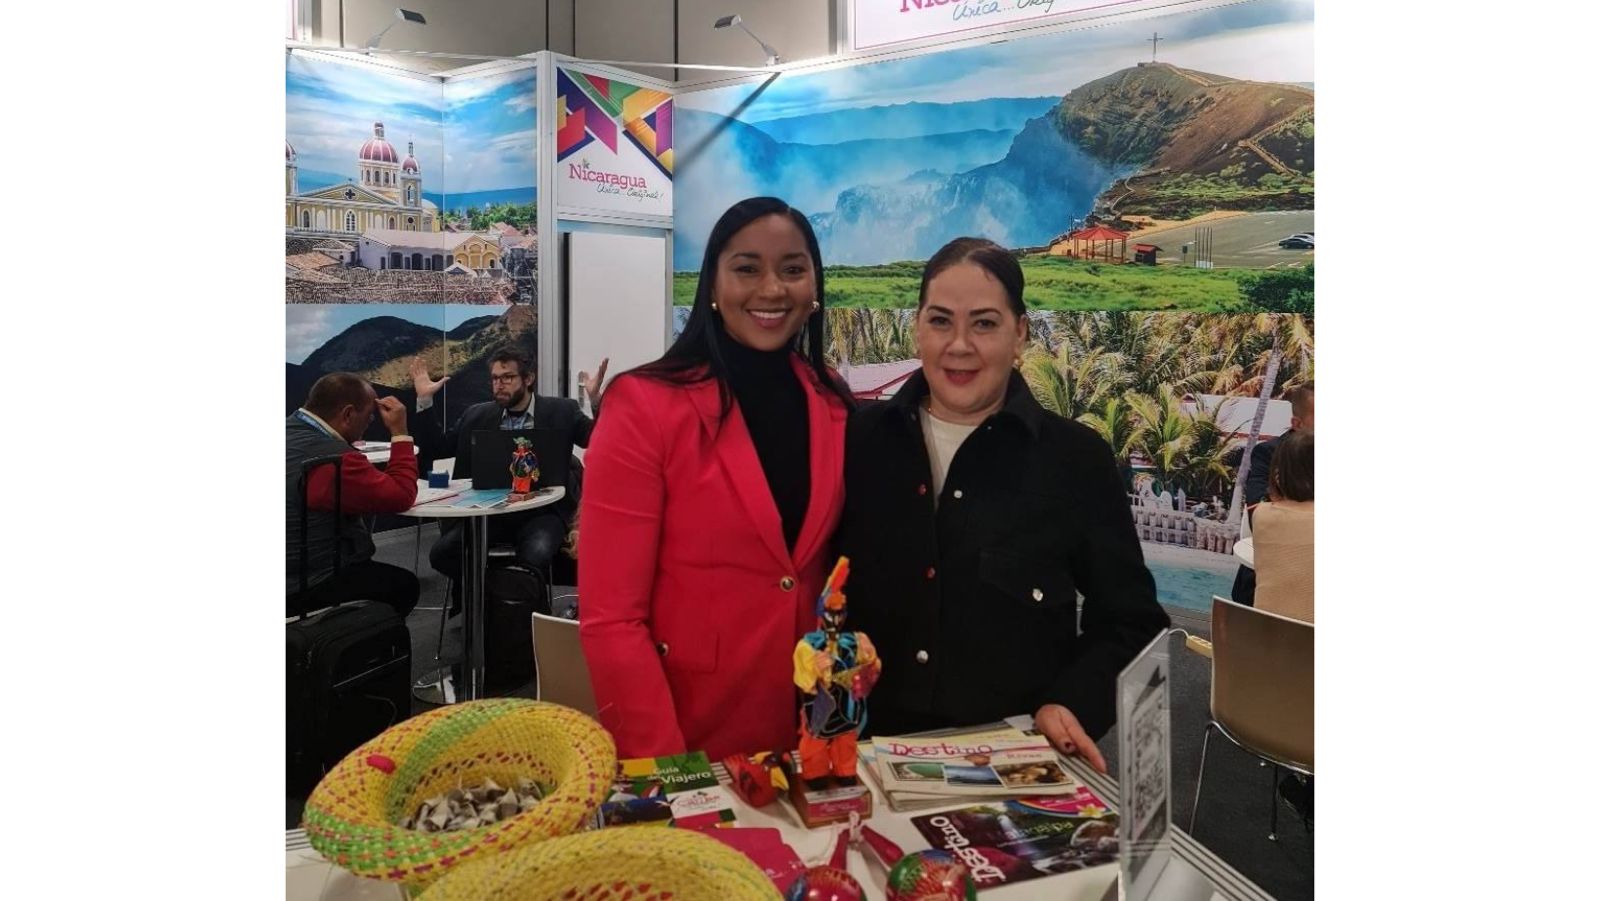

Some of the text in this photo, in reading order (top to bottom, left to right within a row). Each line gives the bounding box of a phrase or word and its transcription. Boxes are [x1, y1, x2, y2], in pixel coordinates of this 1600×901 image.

[569, 163, 647, 189] Nicaragua
[888, 742, 993, 756] Destino
[660, 771, 712, 784] Viajero
[930, 815, 1007, 882] Destino
